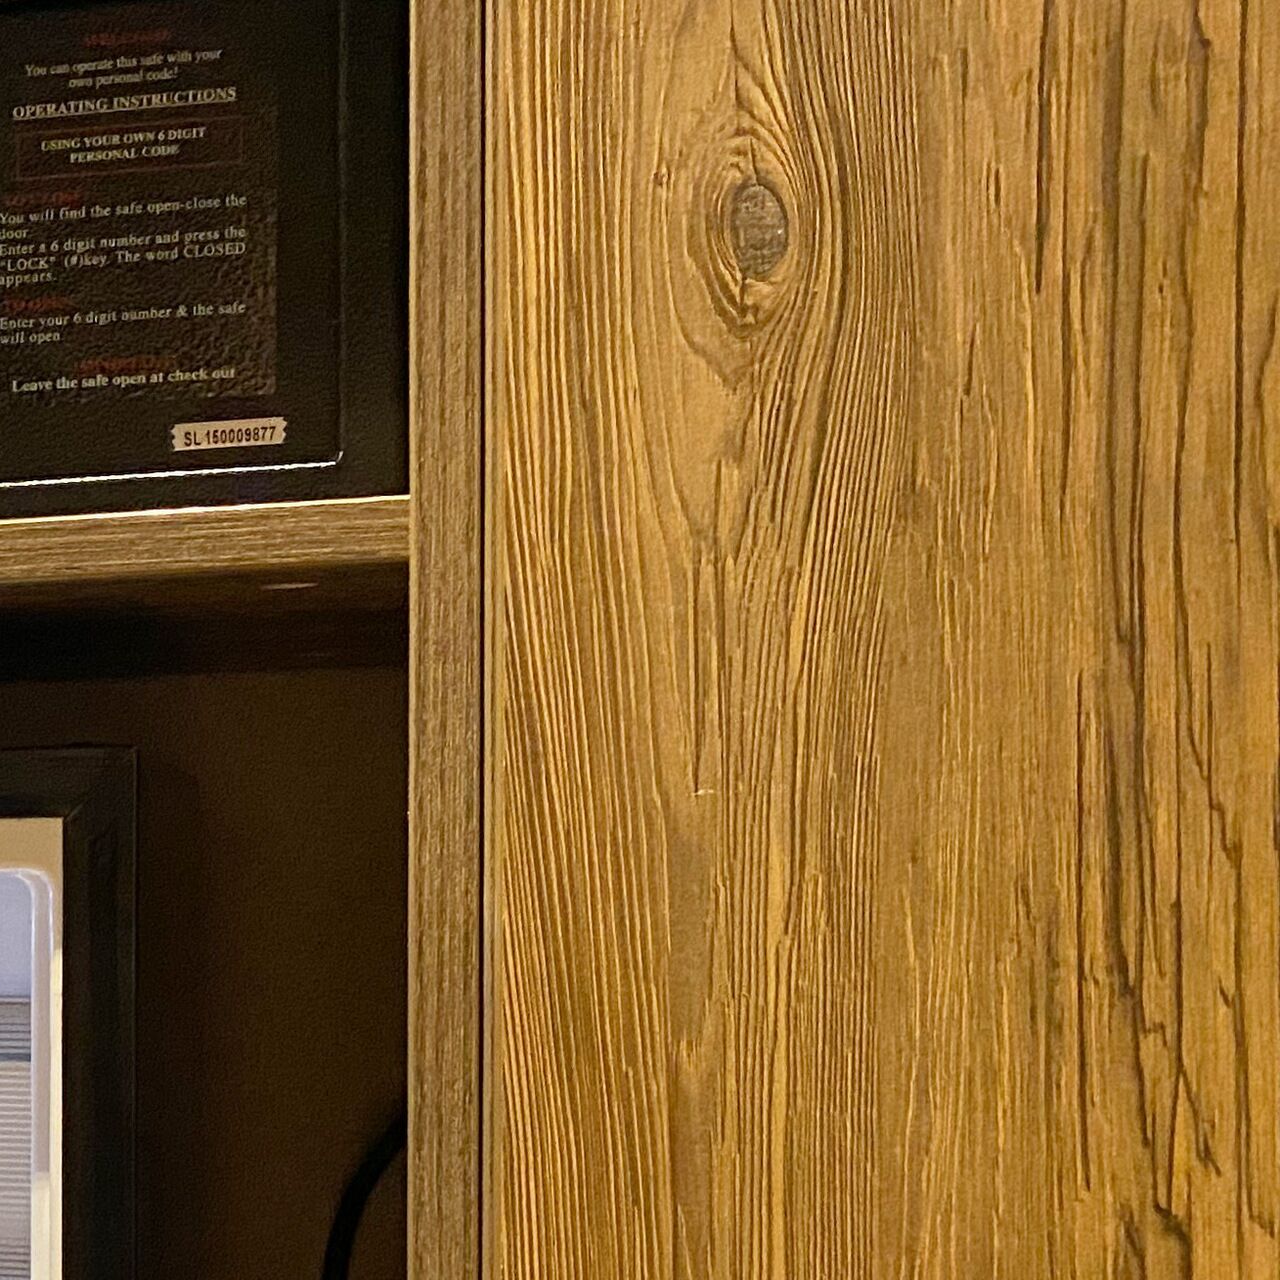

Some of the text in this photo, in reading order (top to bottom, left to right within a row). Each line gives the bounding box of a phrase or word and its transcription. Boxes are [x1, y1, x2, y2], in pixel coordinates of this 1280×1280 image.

[25, 49, 223, 76] You can operate this safe with your
[68, 78, 93, 88] own
[95, 70, 144, 90] personal
[12, 86, 237, 119] OPERATING INSTRUCTIONS
[41, 127, 206, 151] USING YOUR OWN 6 DIGIT
[70, 144, 180, 163] PERSONAL CODE
[0, 193, 247, 225] You will find the safe open-close the
[50, 240, 60, 252] 6
[62, 238, 95, 254] digit
[99, 233, 151, 248] number
[155, 230, 180, 245] and
[184, 229, 221, 244] press
[224, 225, 246, 240] the
[115, 250, 140, 263] The
[145, 246, 179, 261] word
[183, 241, 246, 258] CLOSED
[0, 300, 246, 331] Enter your 6 digit number & the safe
[0, 331, 25, 345] will
[11, 367, 236, 393] Leave the safe open at check out
[204, 426, 277, 445] 150009877
